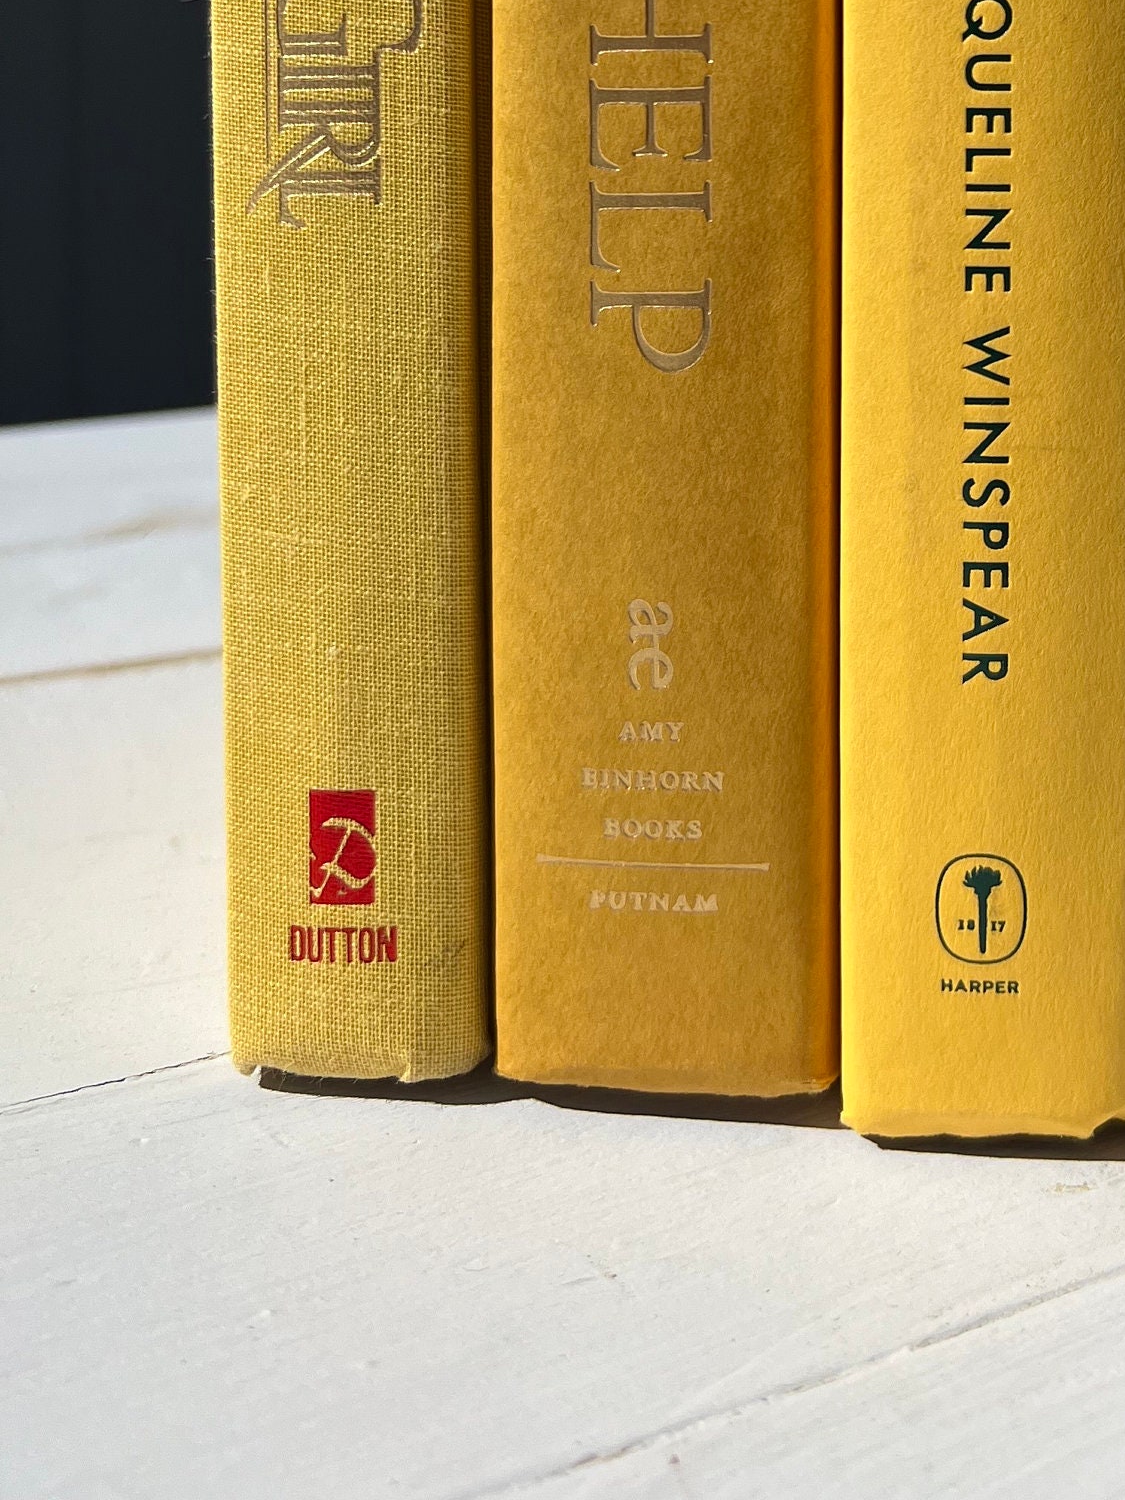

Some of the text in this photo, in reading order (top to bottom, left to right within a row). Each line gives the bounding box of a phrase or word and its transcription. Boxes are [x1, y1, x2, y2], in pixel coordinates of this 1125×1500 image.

[961, 325, 1012, 685] WINSPEAR
[618, 720, 685, 743] AMY
[581, 766, 726, 793] EINHORN
[603, 818, 704, 841] BOOKS
[589, 889, 720, 912] PUTNAM
[289, 925, 398, 965] DUTTON
[940, 977, 1020, 995] HARPER
